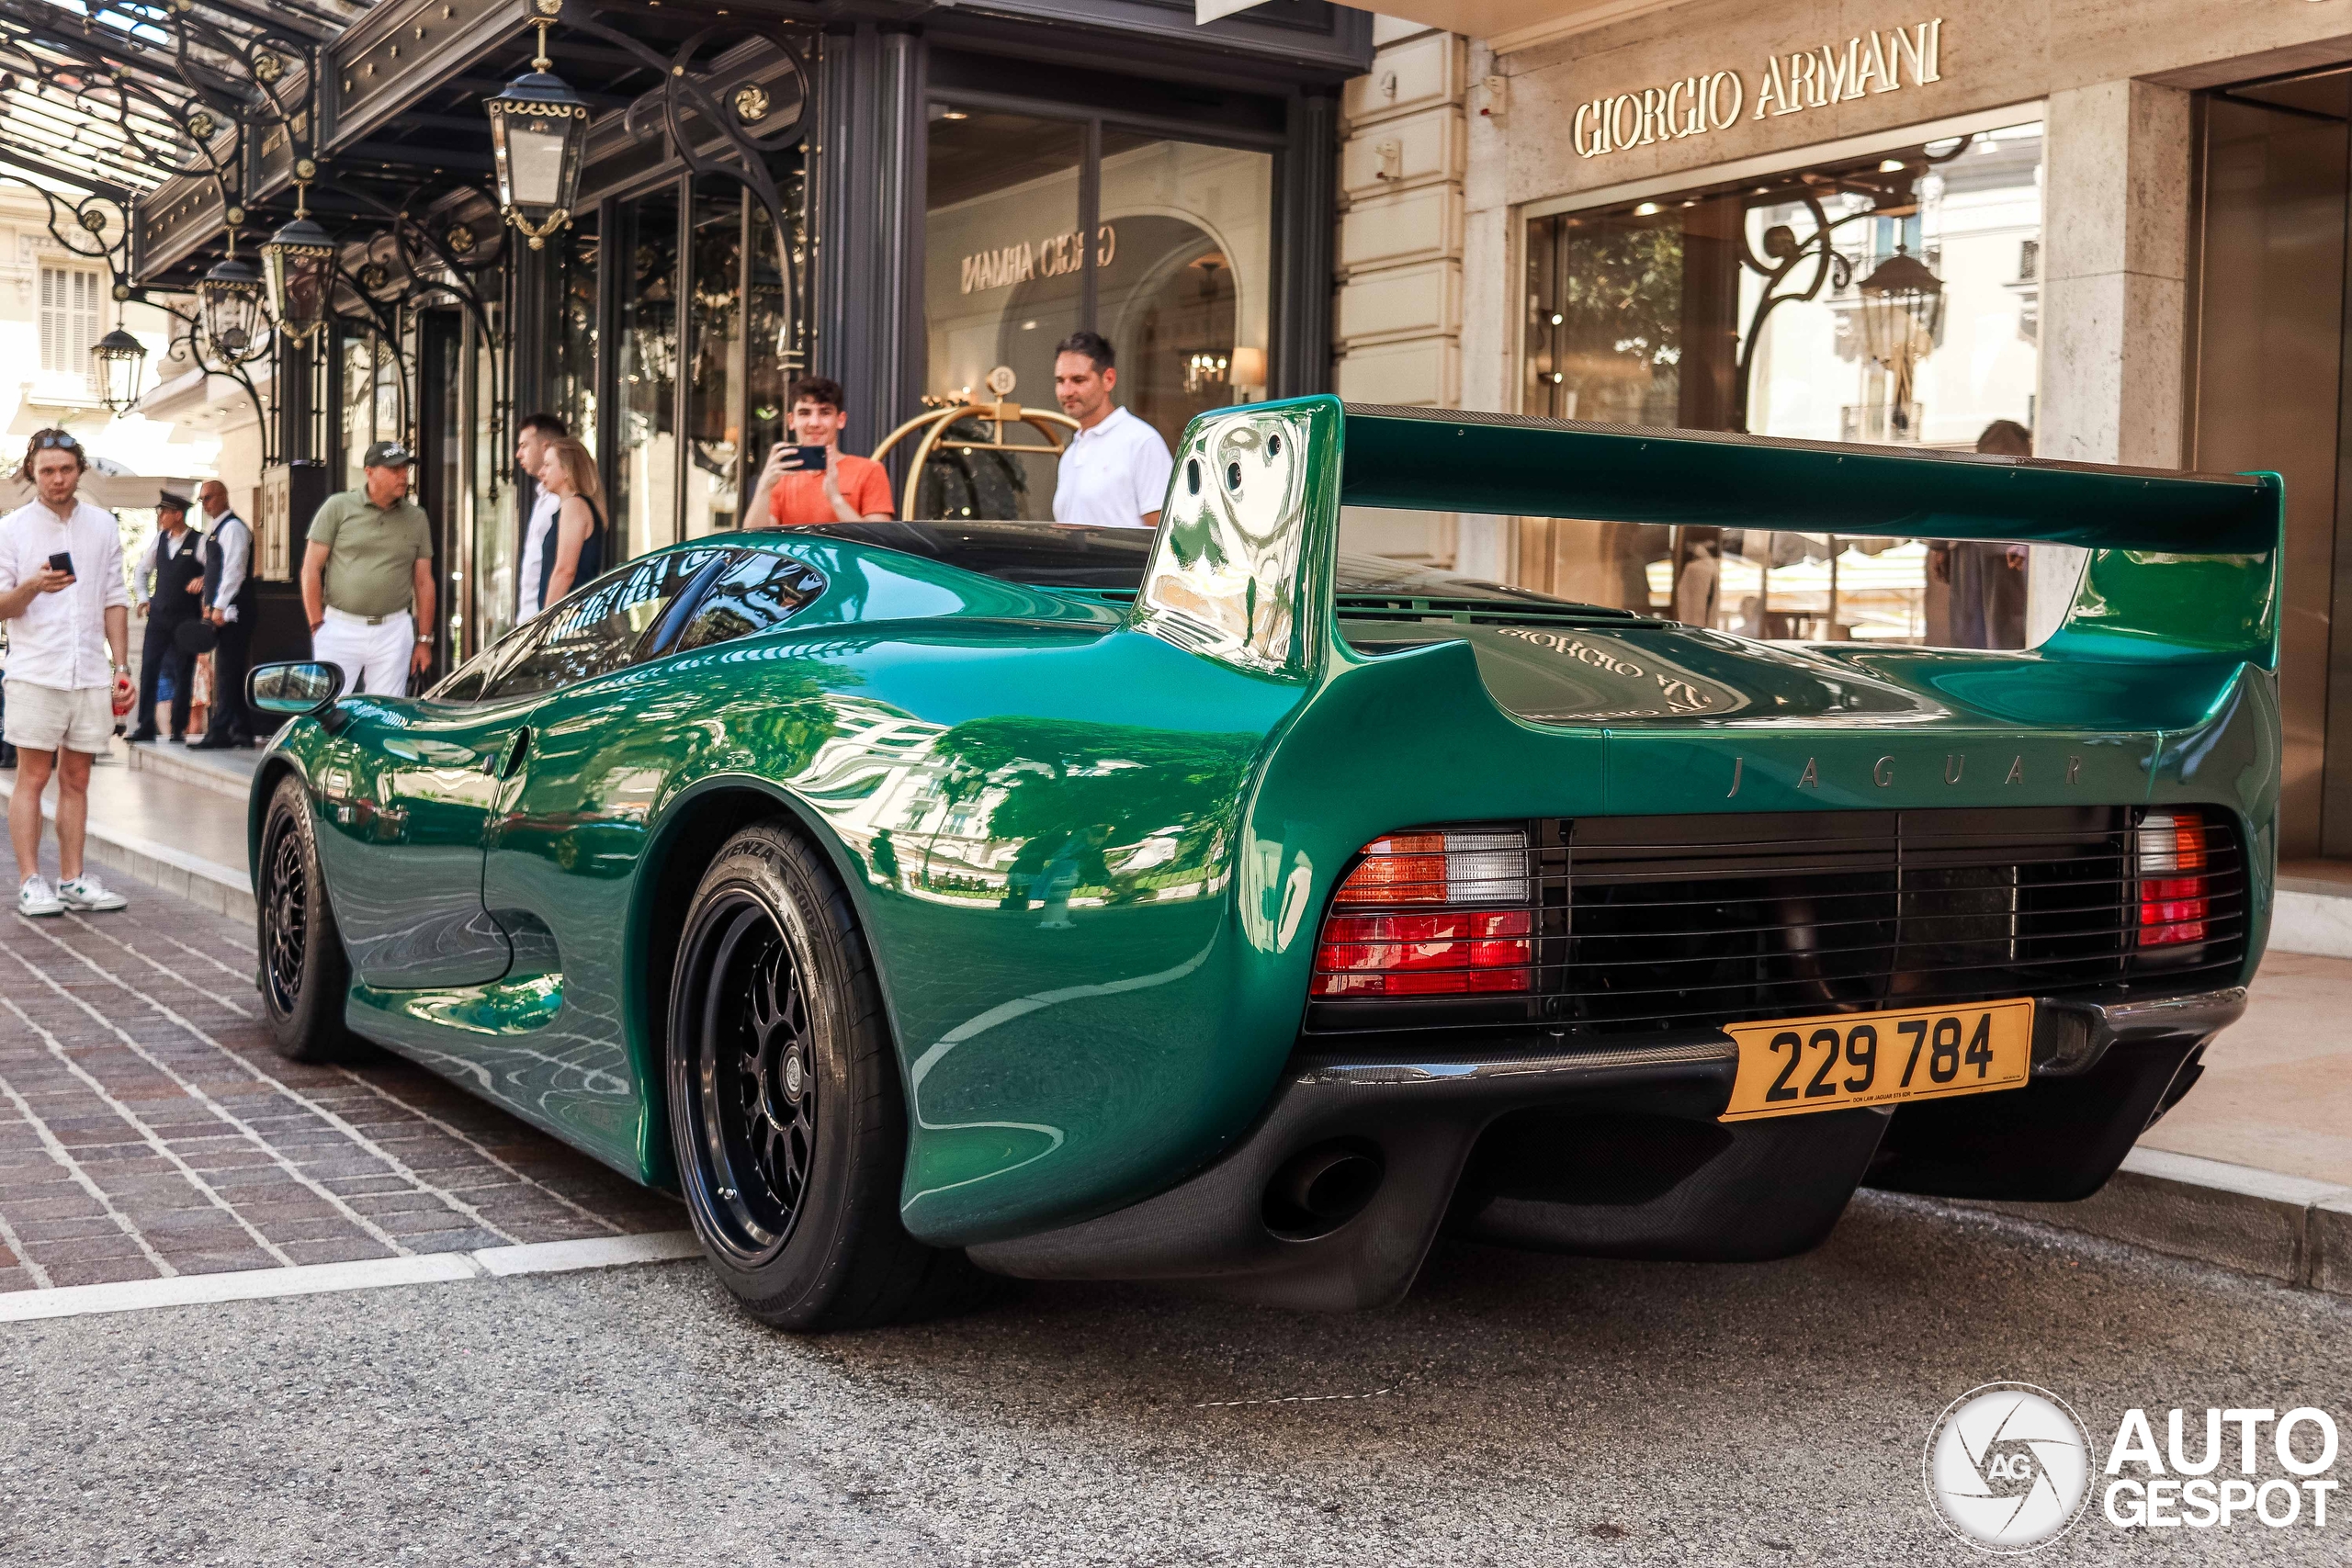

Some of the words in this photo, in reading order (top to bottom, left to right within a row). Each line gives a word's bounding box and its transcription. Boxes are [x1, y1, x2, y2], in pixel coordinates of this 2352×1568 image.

[1574, 69, 1743, 159] GIORGIO
[1751, 17, 1942, 120] ARMANI
[1726, 755, 2082, 798] JAGUAR
[1765, 1023, 1878, 1102] 229
[1896, 1013, 1994, 1089] 784
